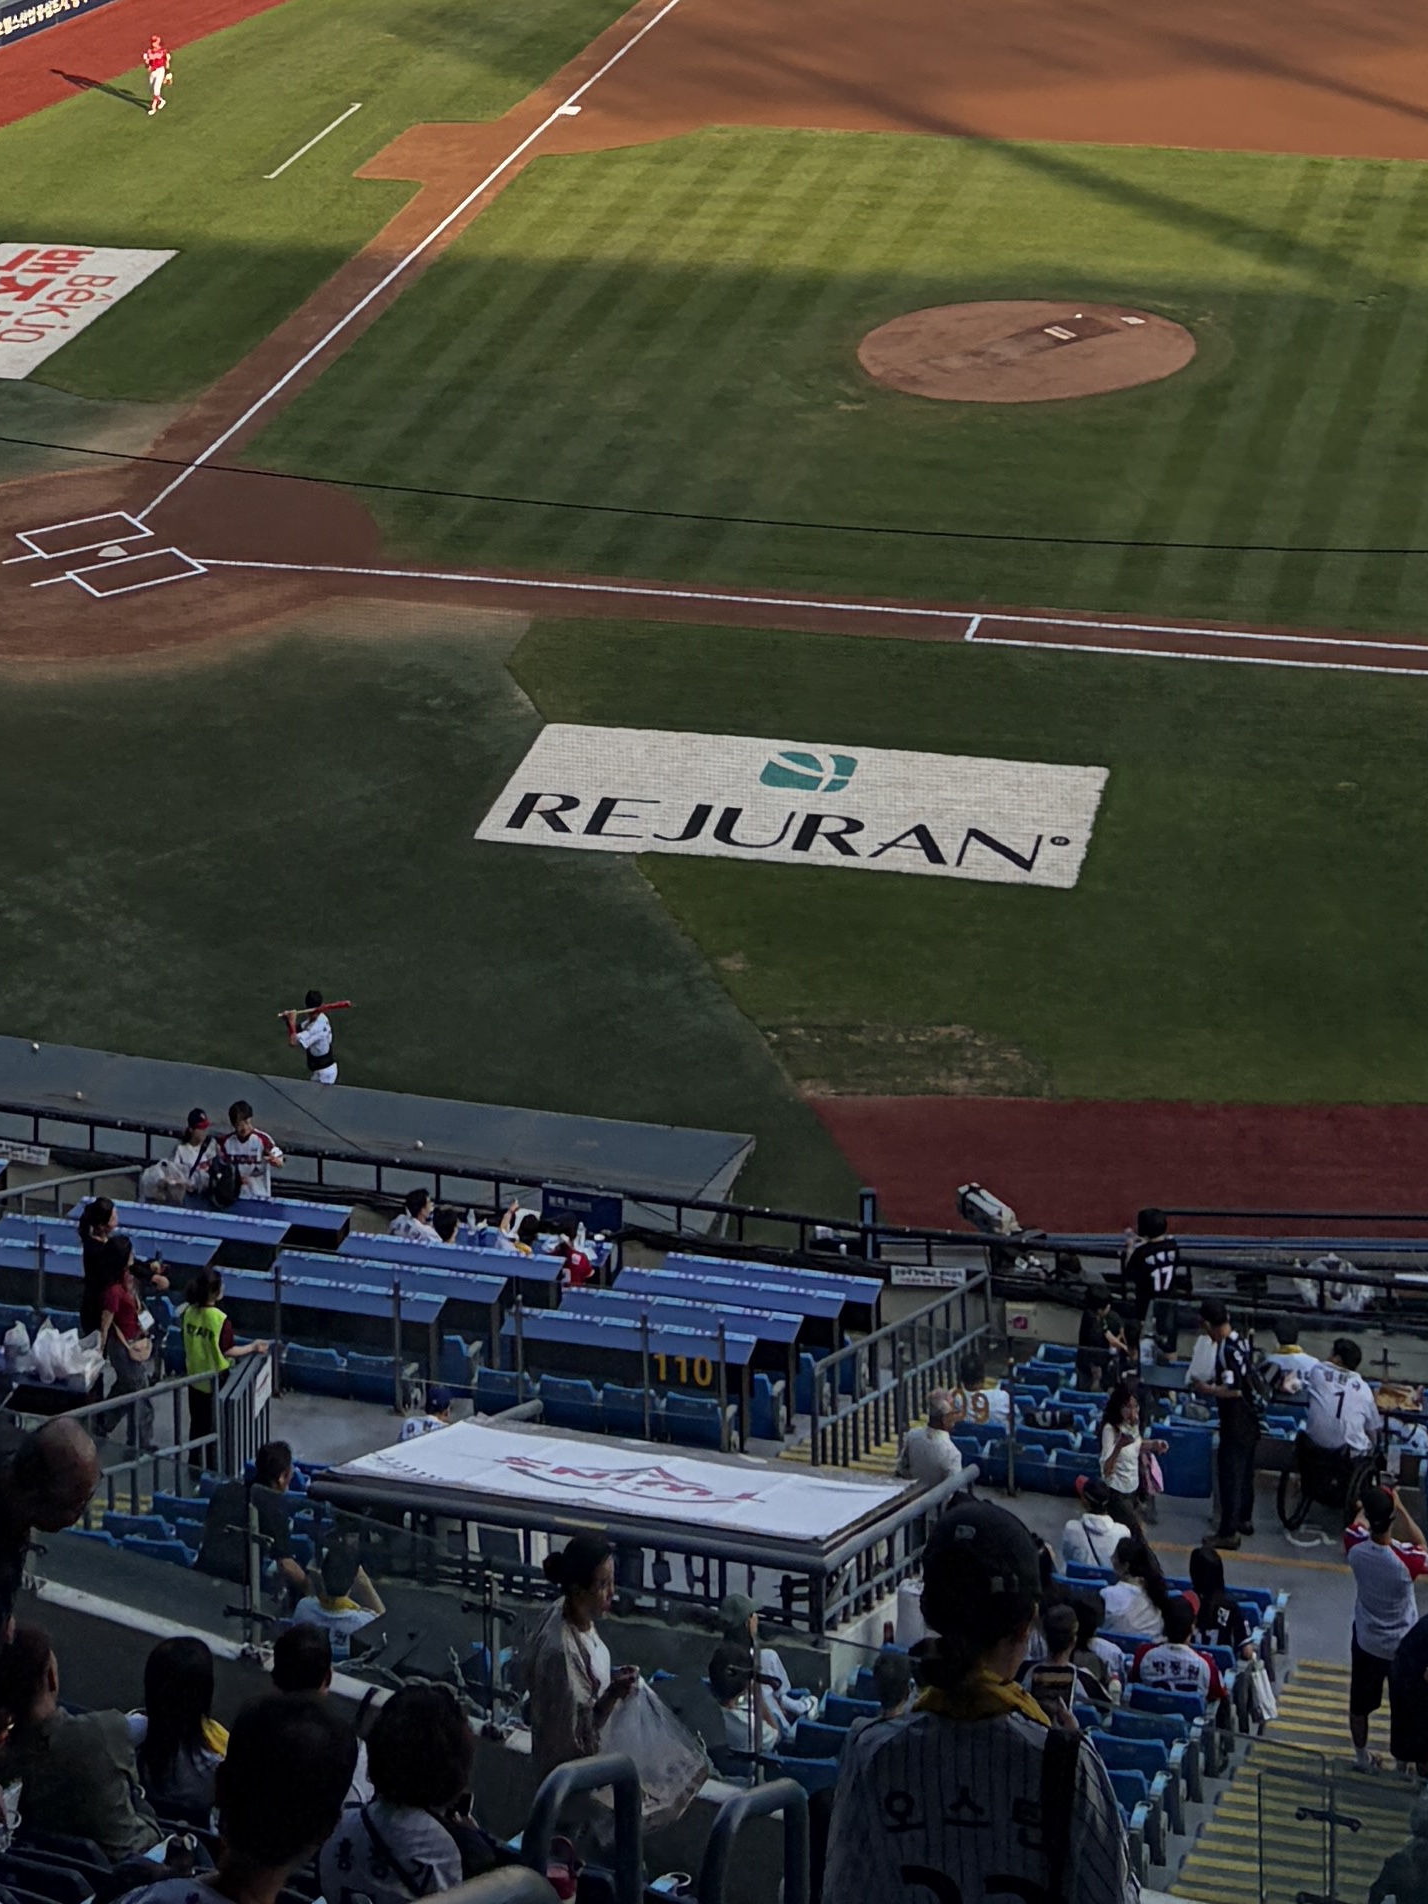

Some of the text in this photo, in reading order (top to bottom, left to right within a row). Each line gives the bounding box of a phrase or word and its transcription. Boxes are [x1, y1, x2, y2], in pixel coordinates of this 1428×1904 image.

[504, 792, 1045, 873] REJURAN
[1154, 1265, 1175, 1293] 17
[653, 1353, 714, 1388] 110
[1333, 1390, 1346, 1420] 7
